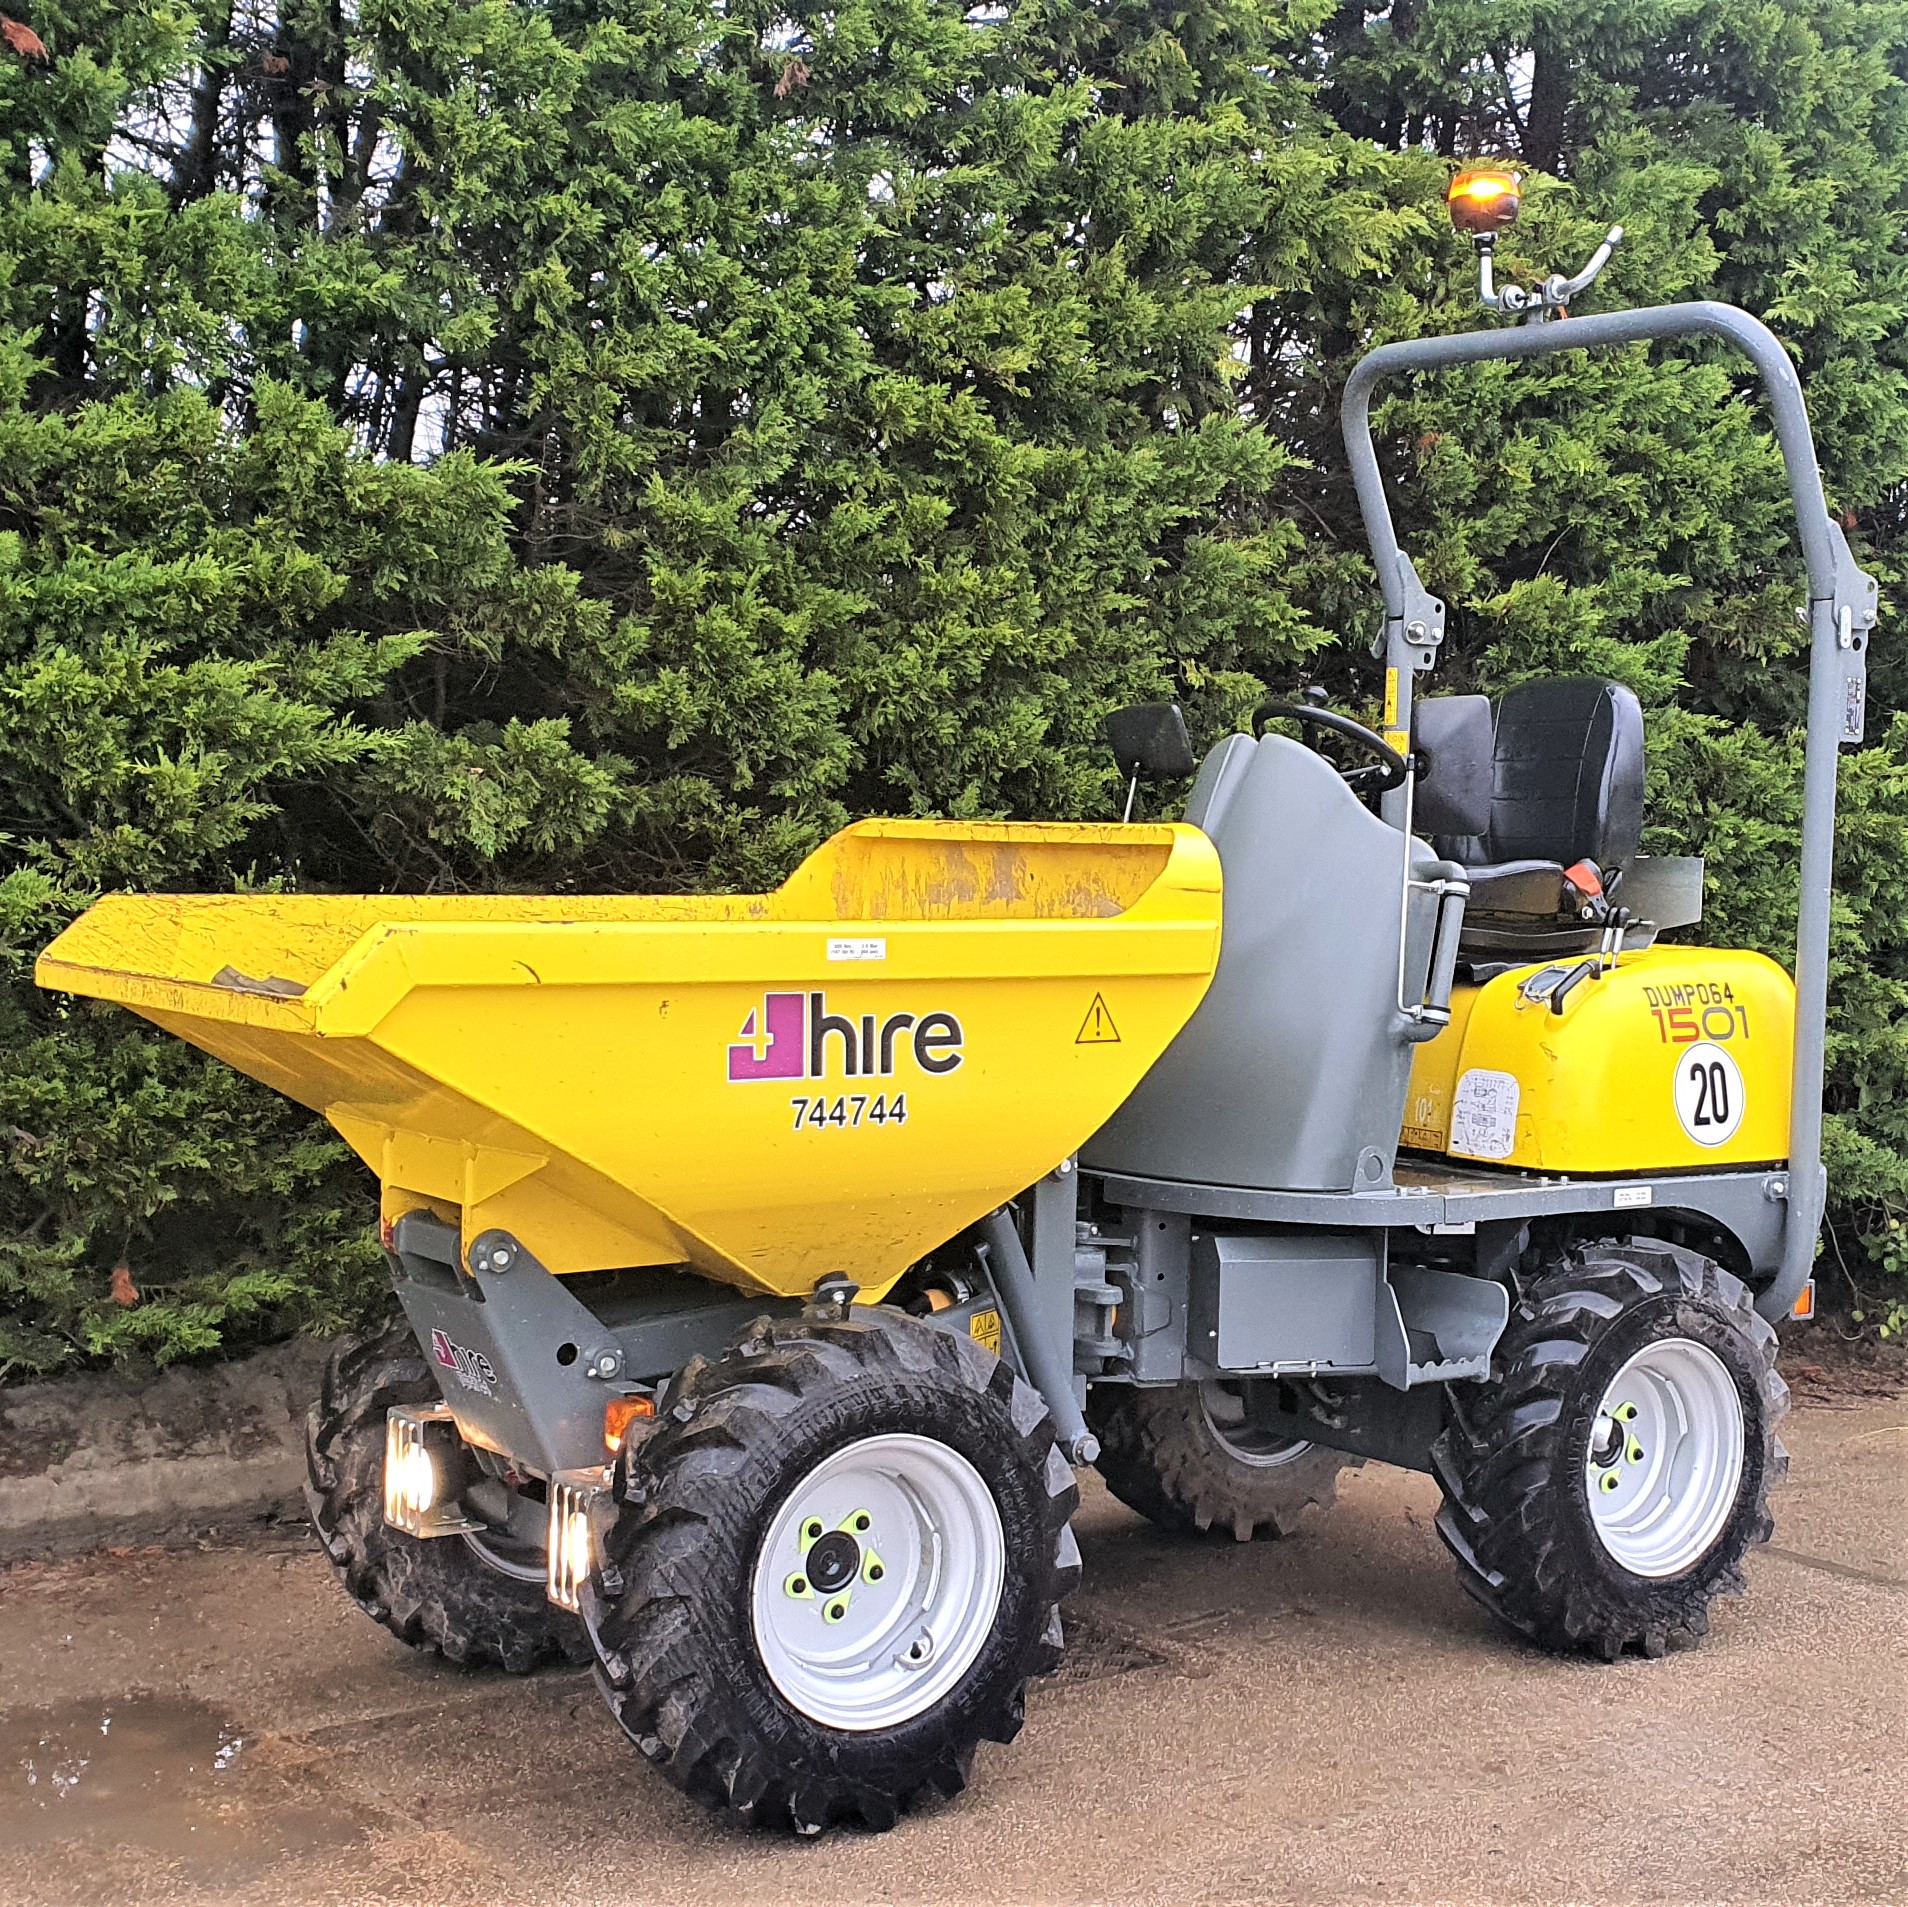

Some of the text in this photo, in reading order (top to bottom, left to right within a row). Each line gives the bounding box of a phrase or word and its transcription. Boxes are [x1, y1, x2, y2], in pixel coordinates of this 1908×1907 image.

[1651, 1005, 1749, 1044] 1501
[791, 1094, 907, 1129] 744744
[1690, 1061, 1730, 1126] 20
